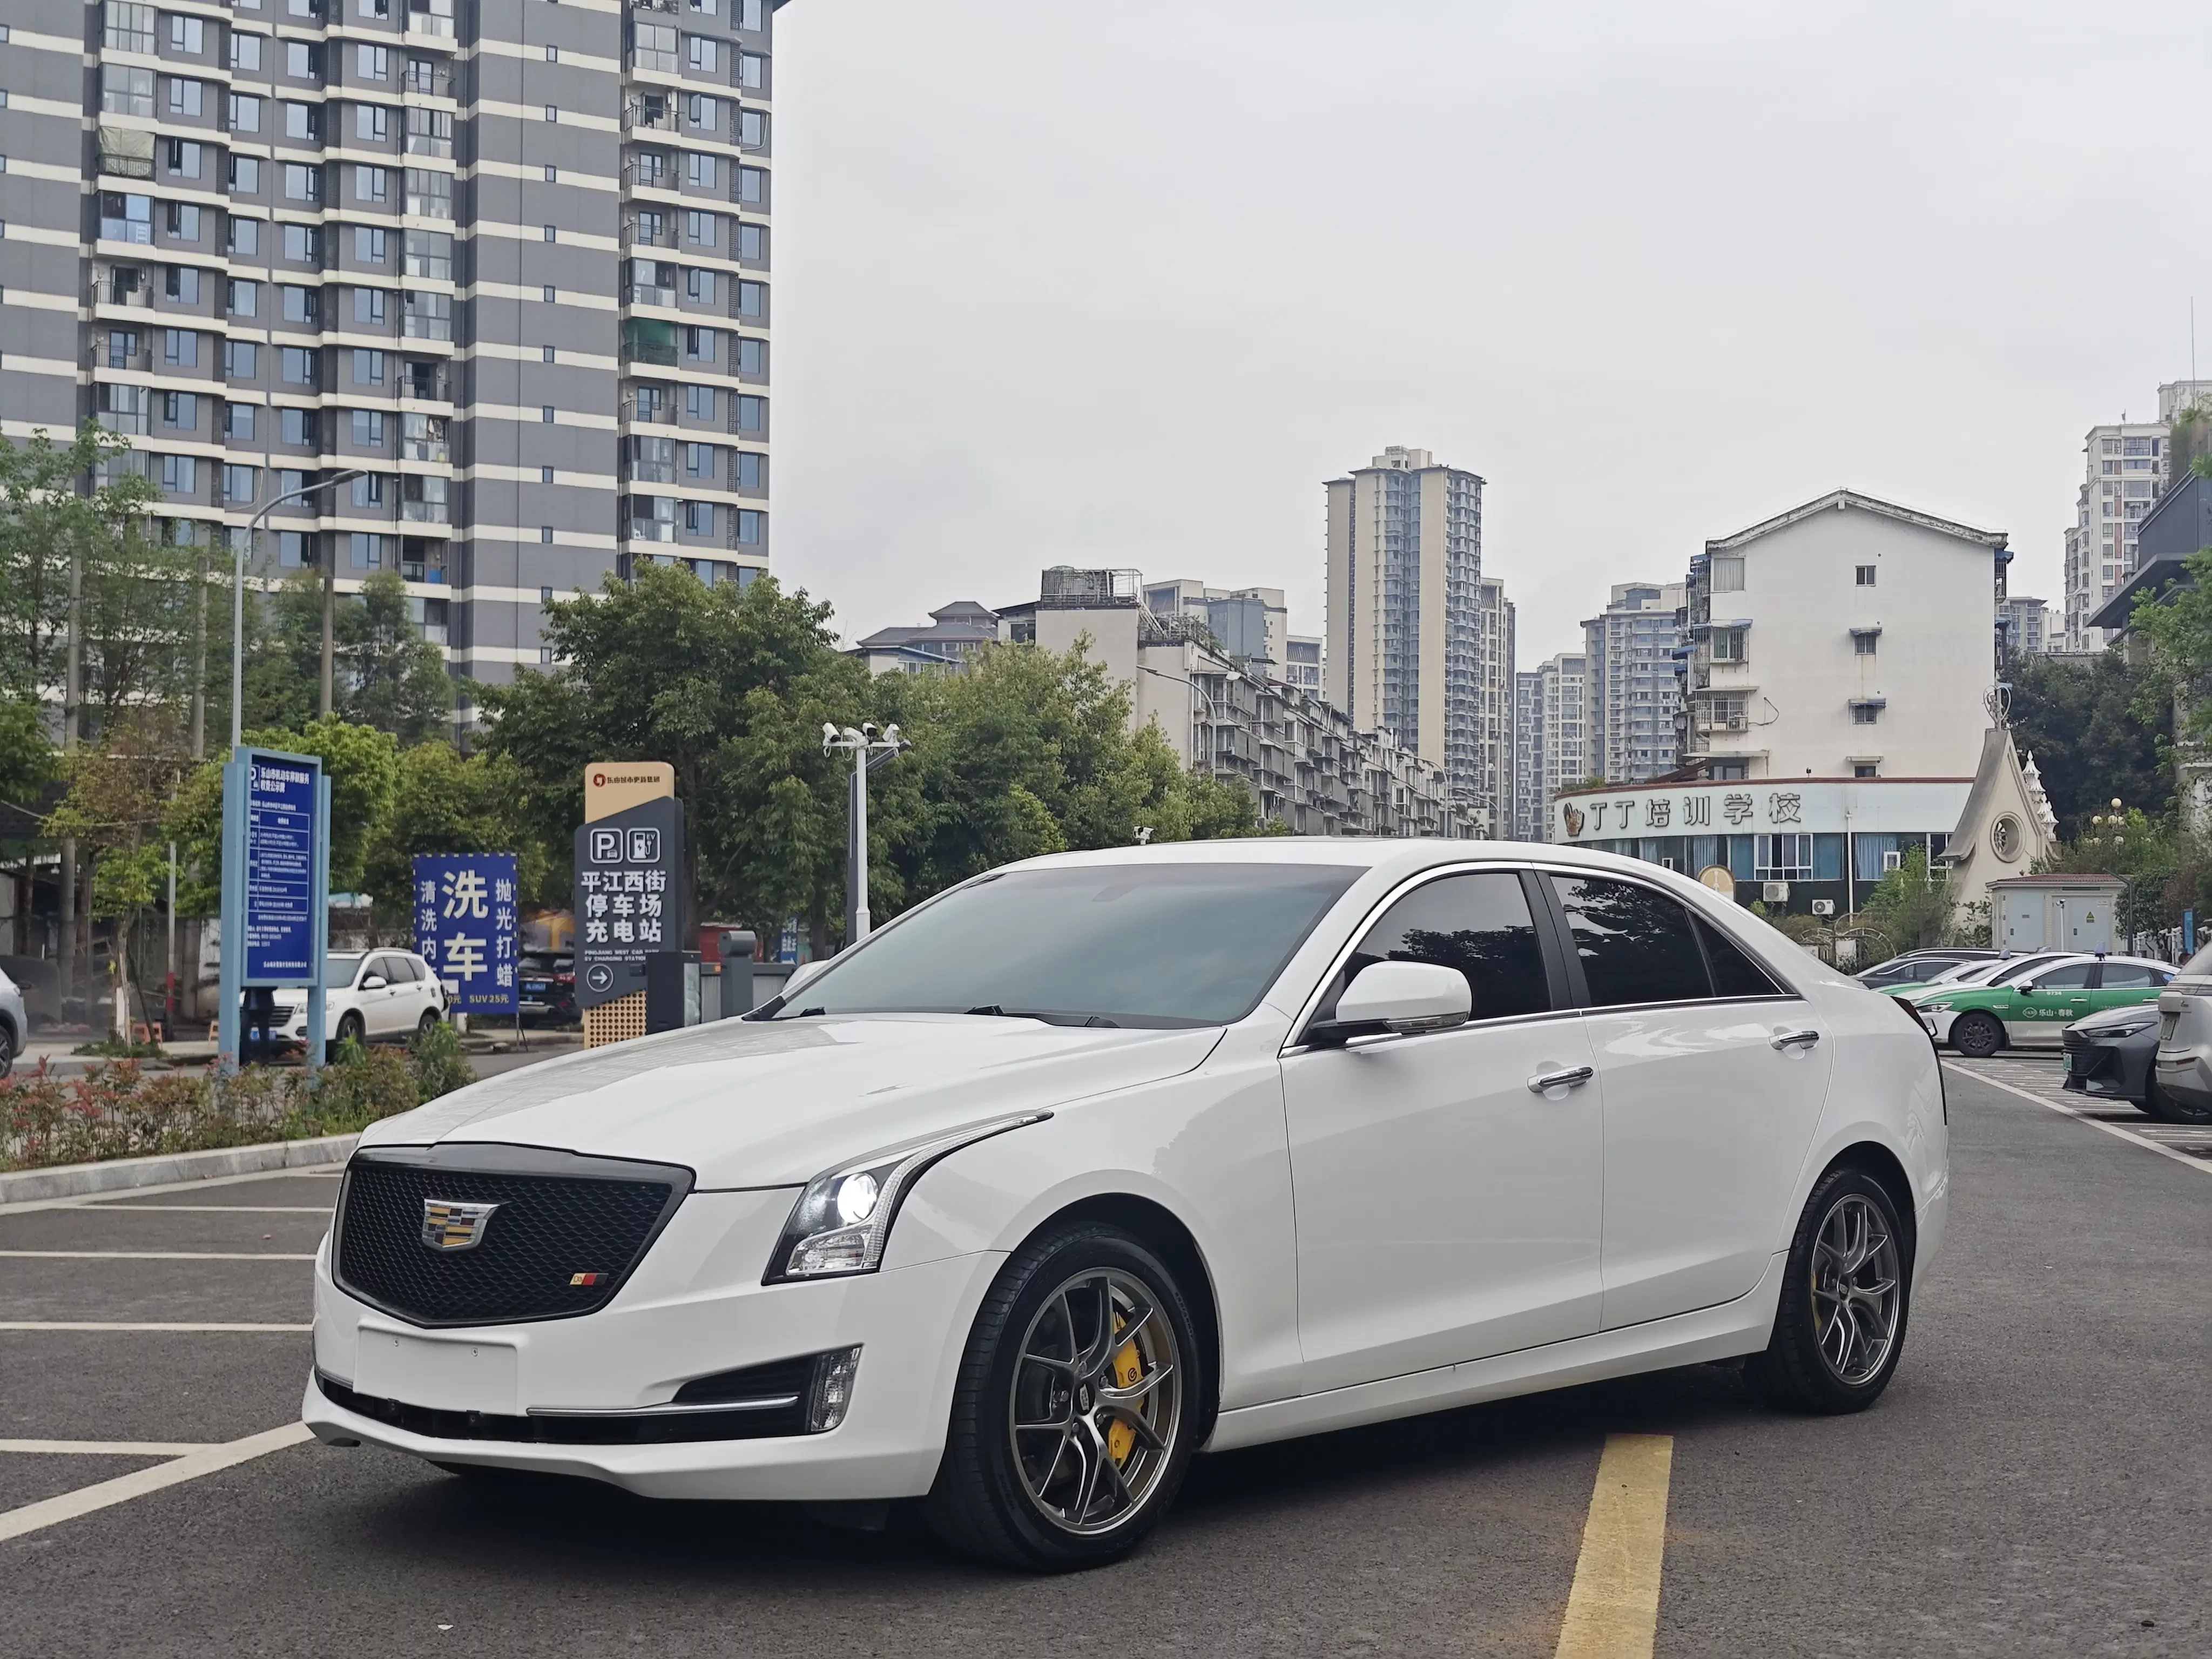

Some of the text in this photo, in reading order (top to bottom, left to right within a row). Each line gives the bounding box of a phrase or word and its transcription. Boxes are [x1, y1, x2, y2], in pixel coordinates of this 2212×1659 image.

[1589, 793, 1802, 831] 丁丁培训学校
[597, 833, 615, 859] P
[581, 869, 666, 892] 平江西街
[585, 893, 662, 918] 停车场
[421, 880, 437, 973] 清洗内
[442, 869, 489, 981] 洗车
[496, 878, 512, 987] 抛光打蜡
[586, 919, 662, 943] 充电站
[469, 994, 488, 1003] SUV
